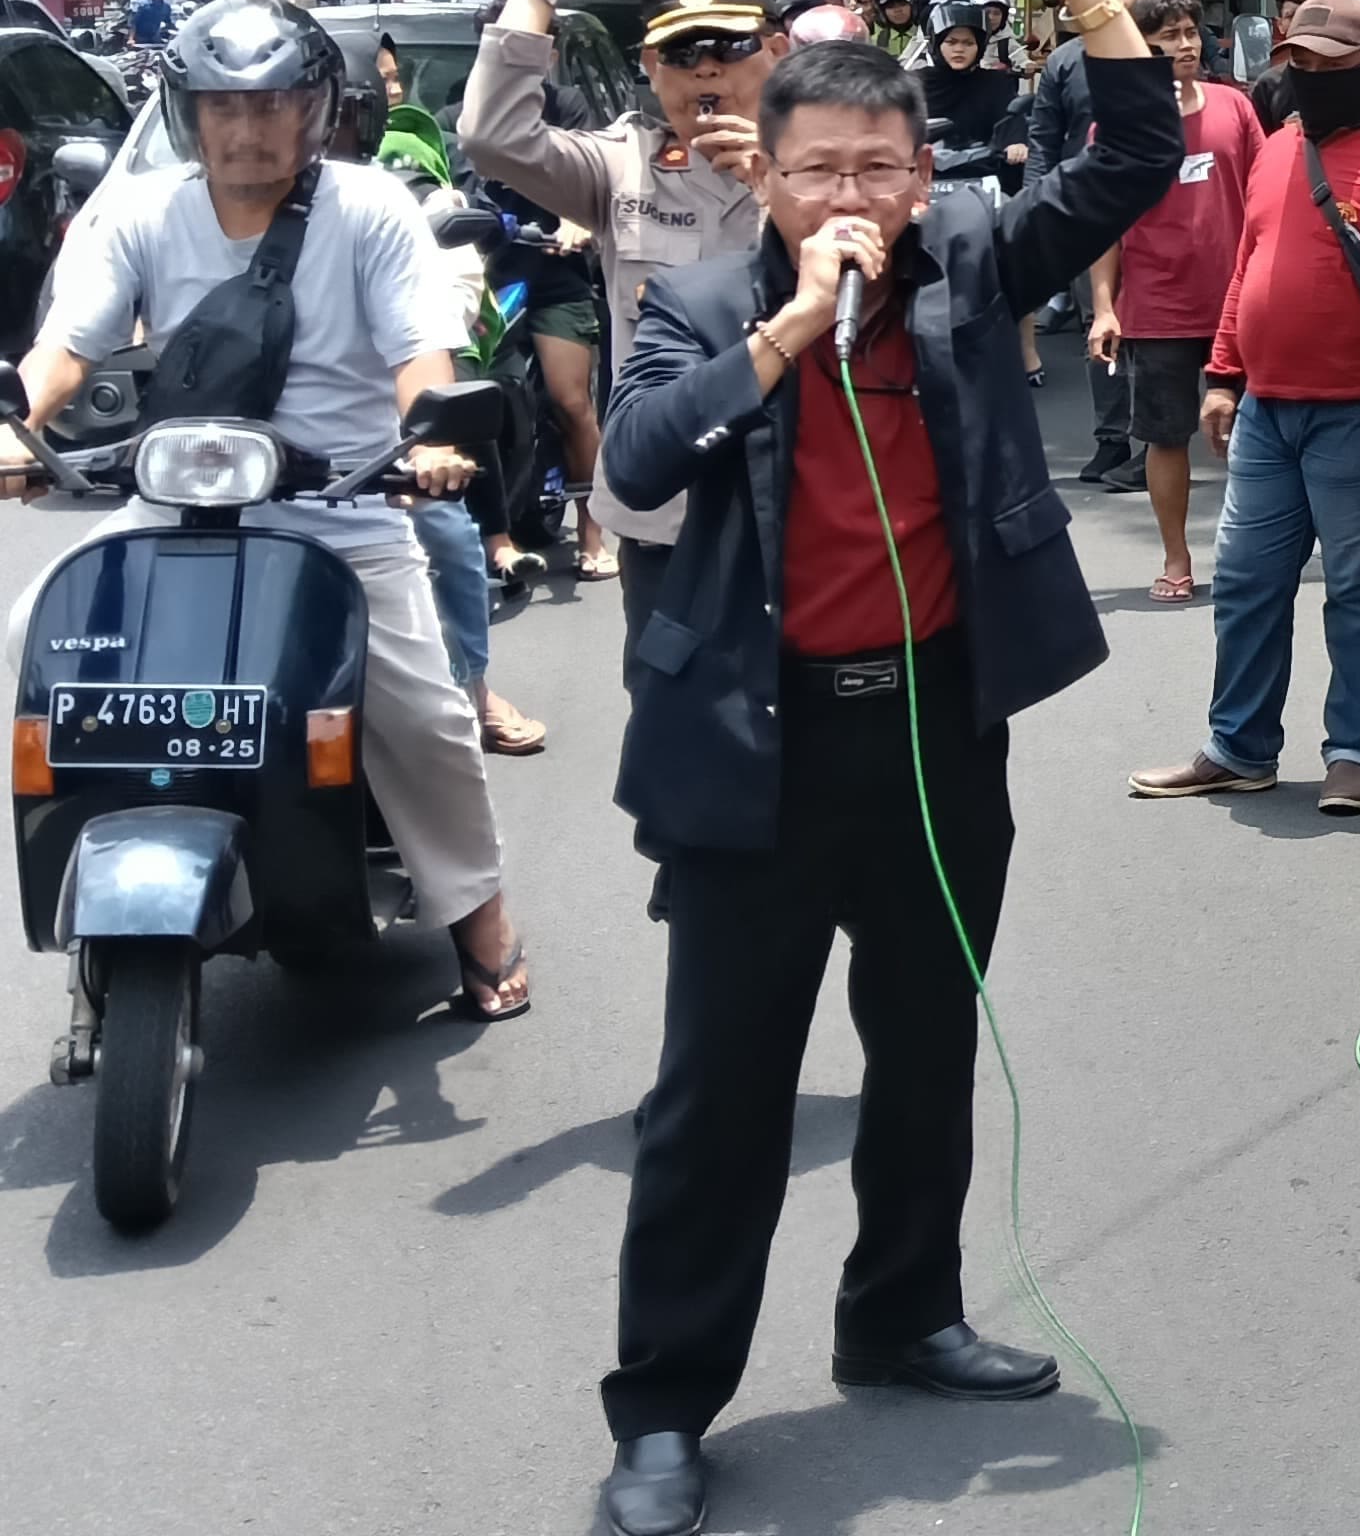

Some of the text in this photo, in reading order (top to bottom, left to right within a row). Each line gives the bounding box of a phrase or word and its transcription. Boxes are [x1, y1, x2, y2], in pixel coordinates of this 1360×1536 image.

[622, 199, 697, 228] SUGENG
[50, 633, 127, 652] vespa
[57, 693, 260, 726] P 4763 HT
